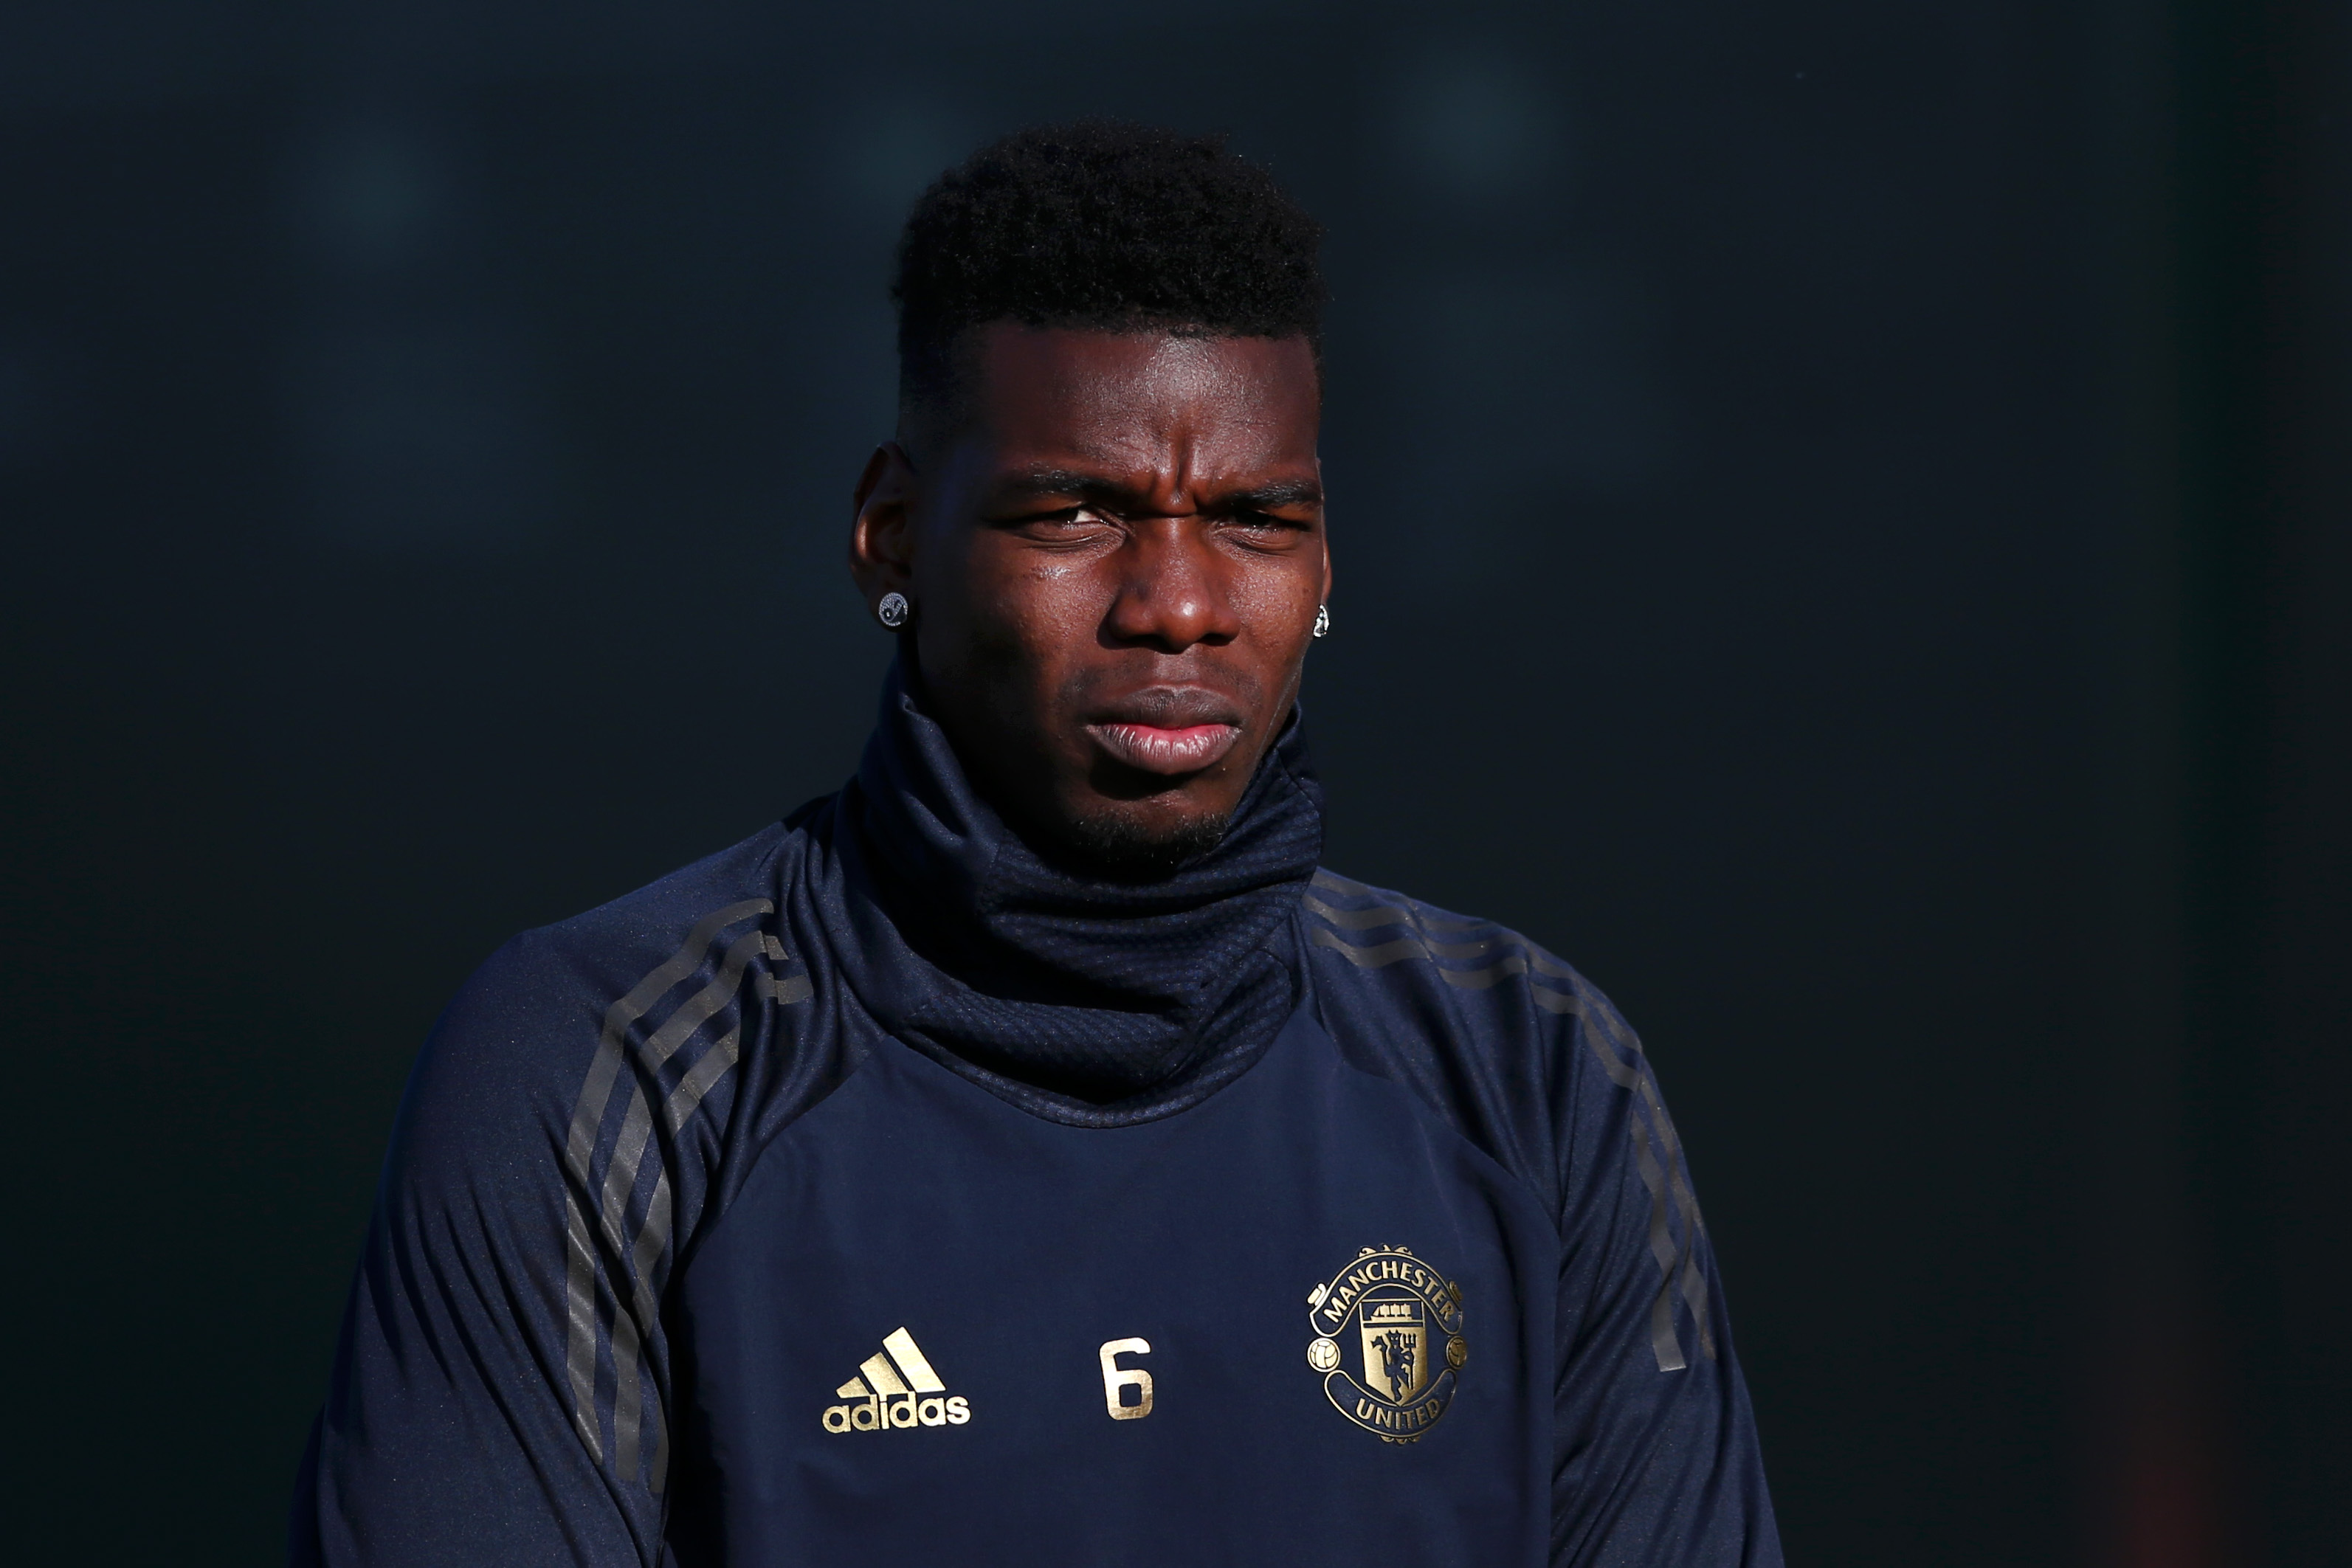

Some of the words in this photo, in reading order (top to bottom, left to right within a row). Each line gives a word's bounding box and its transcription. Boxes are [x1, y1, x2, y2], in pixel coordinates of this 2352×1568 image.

[1324, 1260, 1455, 1323] MANCHESTER
[1099, 1337, 1153, 1420] 6
[822, 1391, 970, 1434] adidas
[1356, 1398, 1440, 1430] UNITED
